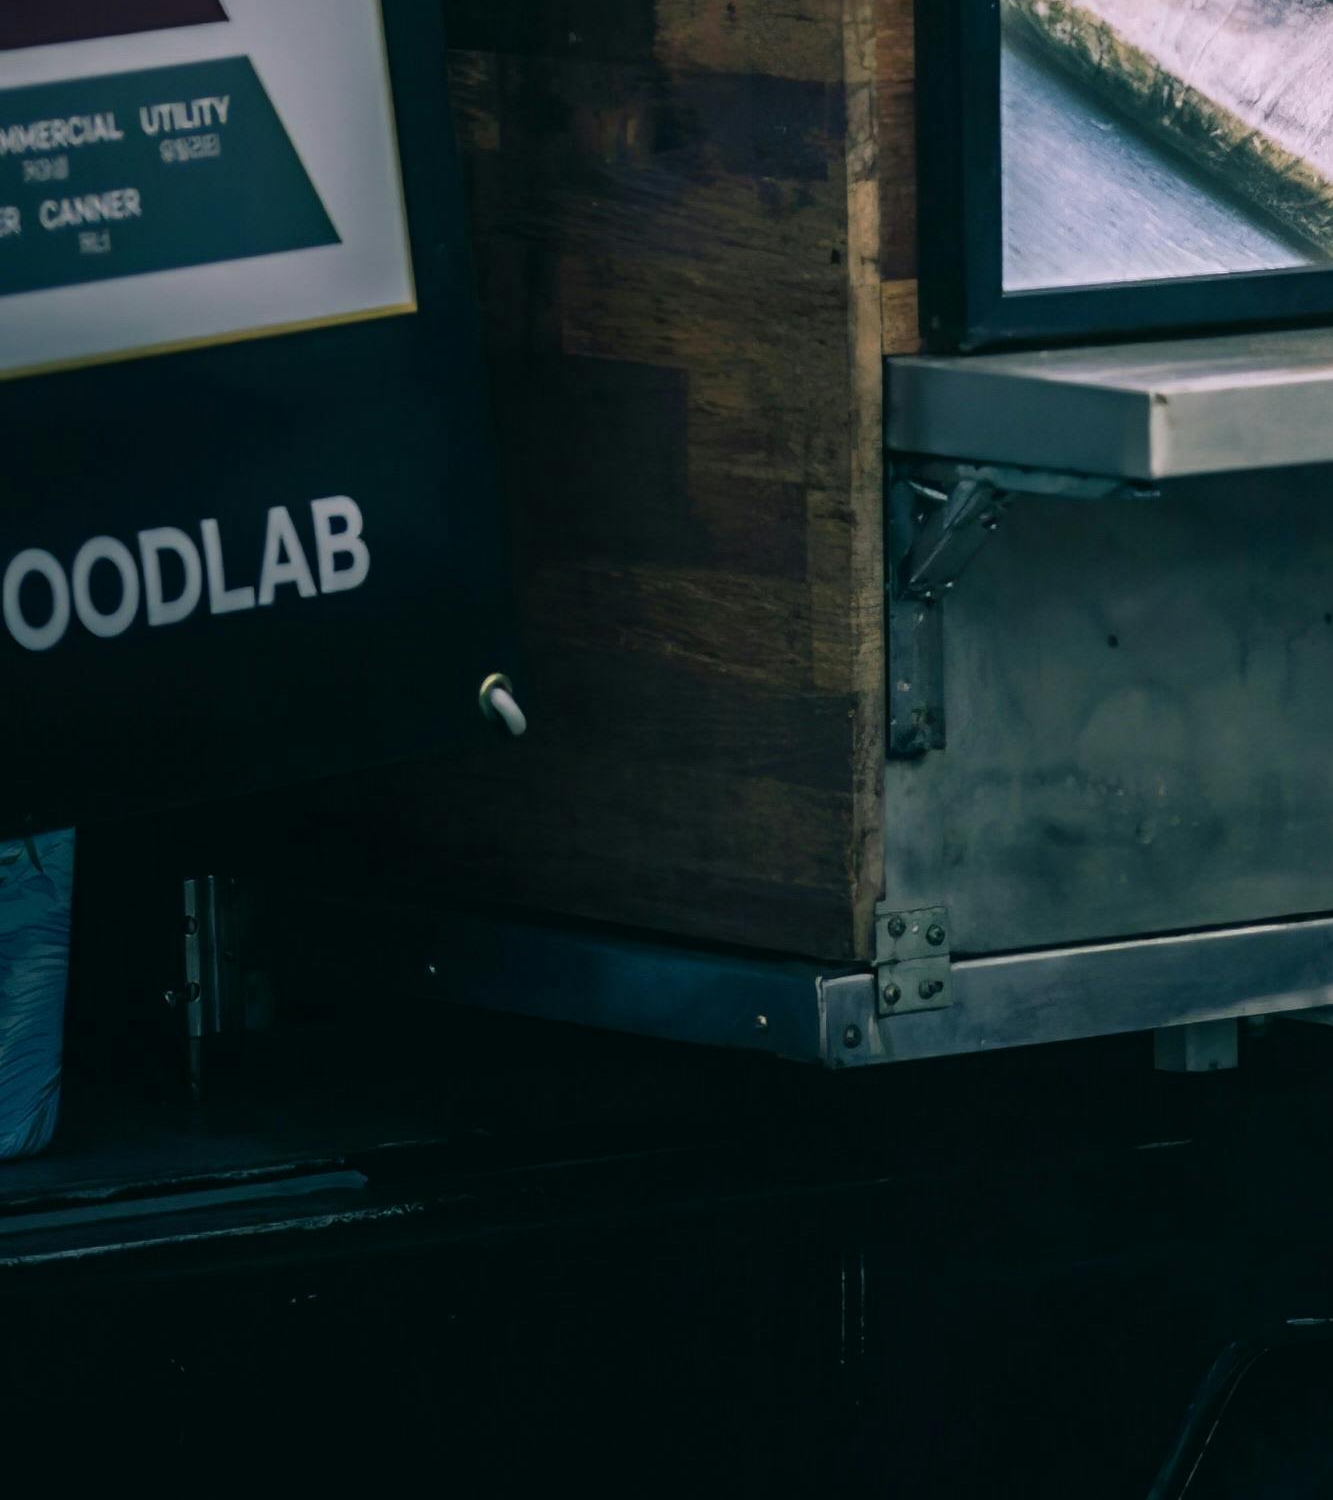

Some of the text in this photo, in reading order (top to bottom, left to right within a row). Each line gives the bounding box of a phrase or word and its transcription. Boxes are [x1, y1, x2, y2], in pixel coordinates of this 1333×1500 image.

[139, 94, 231, 136] UTILITY
[38, 187, 143, 232] CANNER
[1, 493, 372, 653] OODLAB
